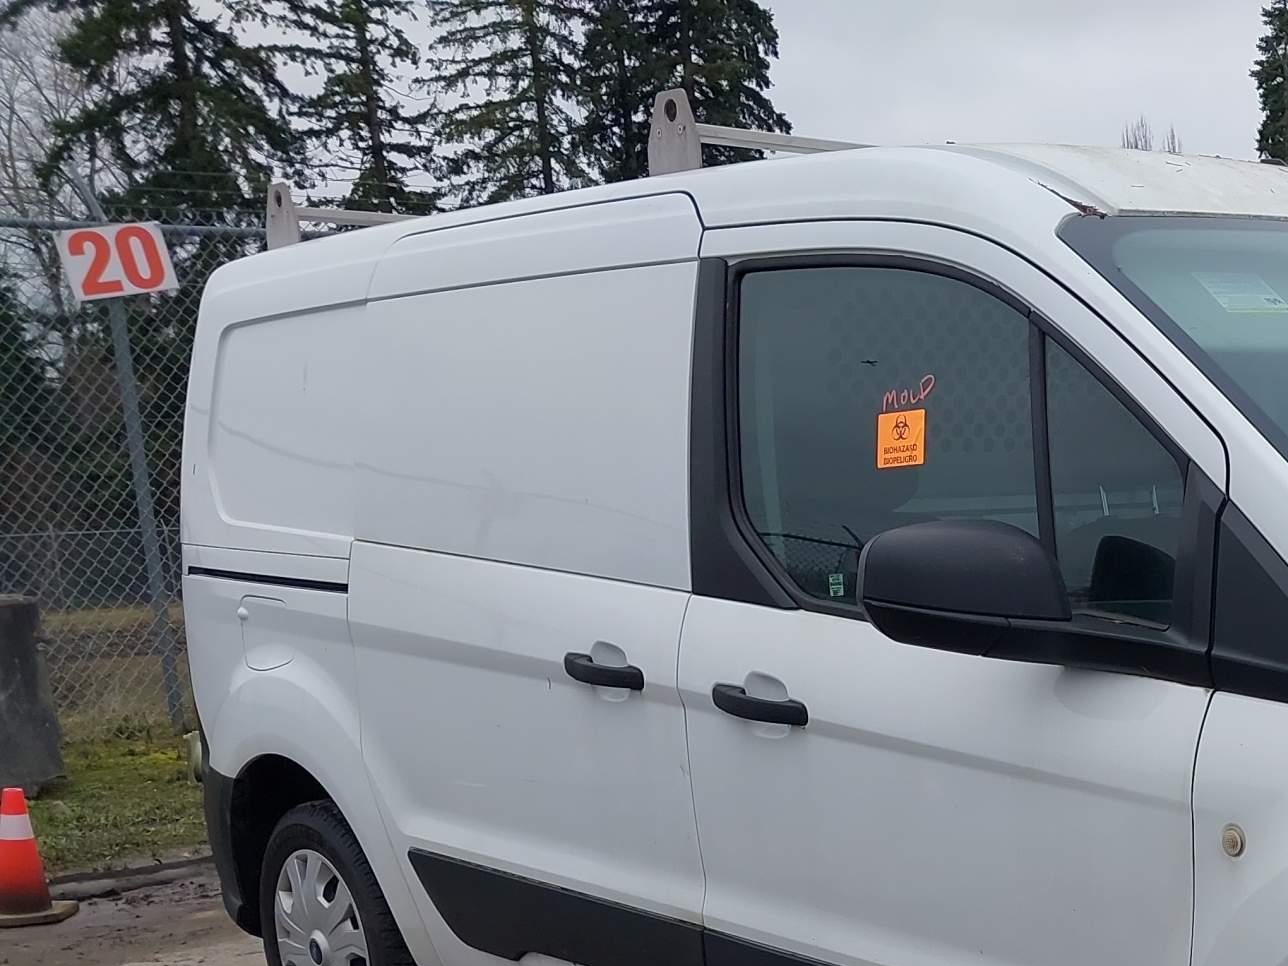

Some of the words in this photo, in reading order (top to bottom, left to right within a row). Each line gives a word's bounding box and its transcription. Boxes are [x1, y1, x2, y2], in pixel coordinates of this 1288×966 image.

[67, 225, 166, 296] 20
[883, 374, 935, 412] MOLD
[883, 443, 918, 455] BIOHAZARD
